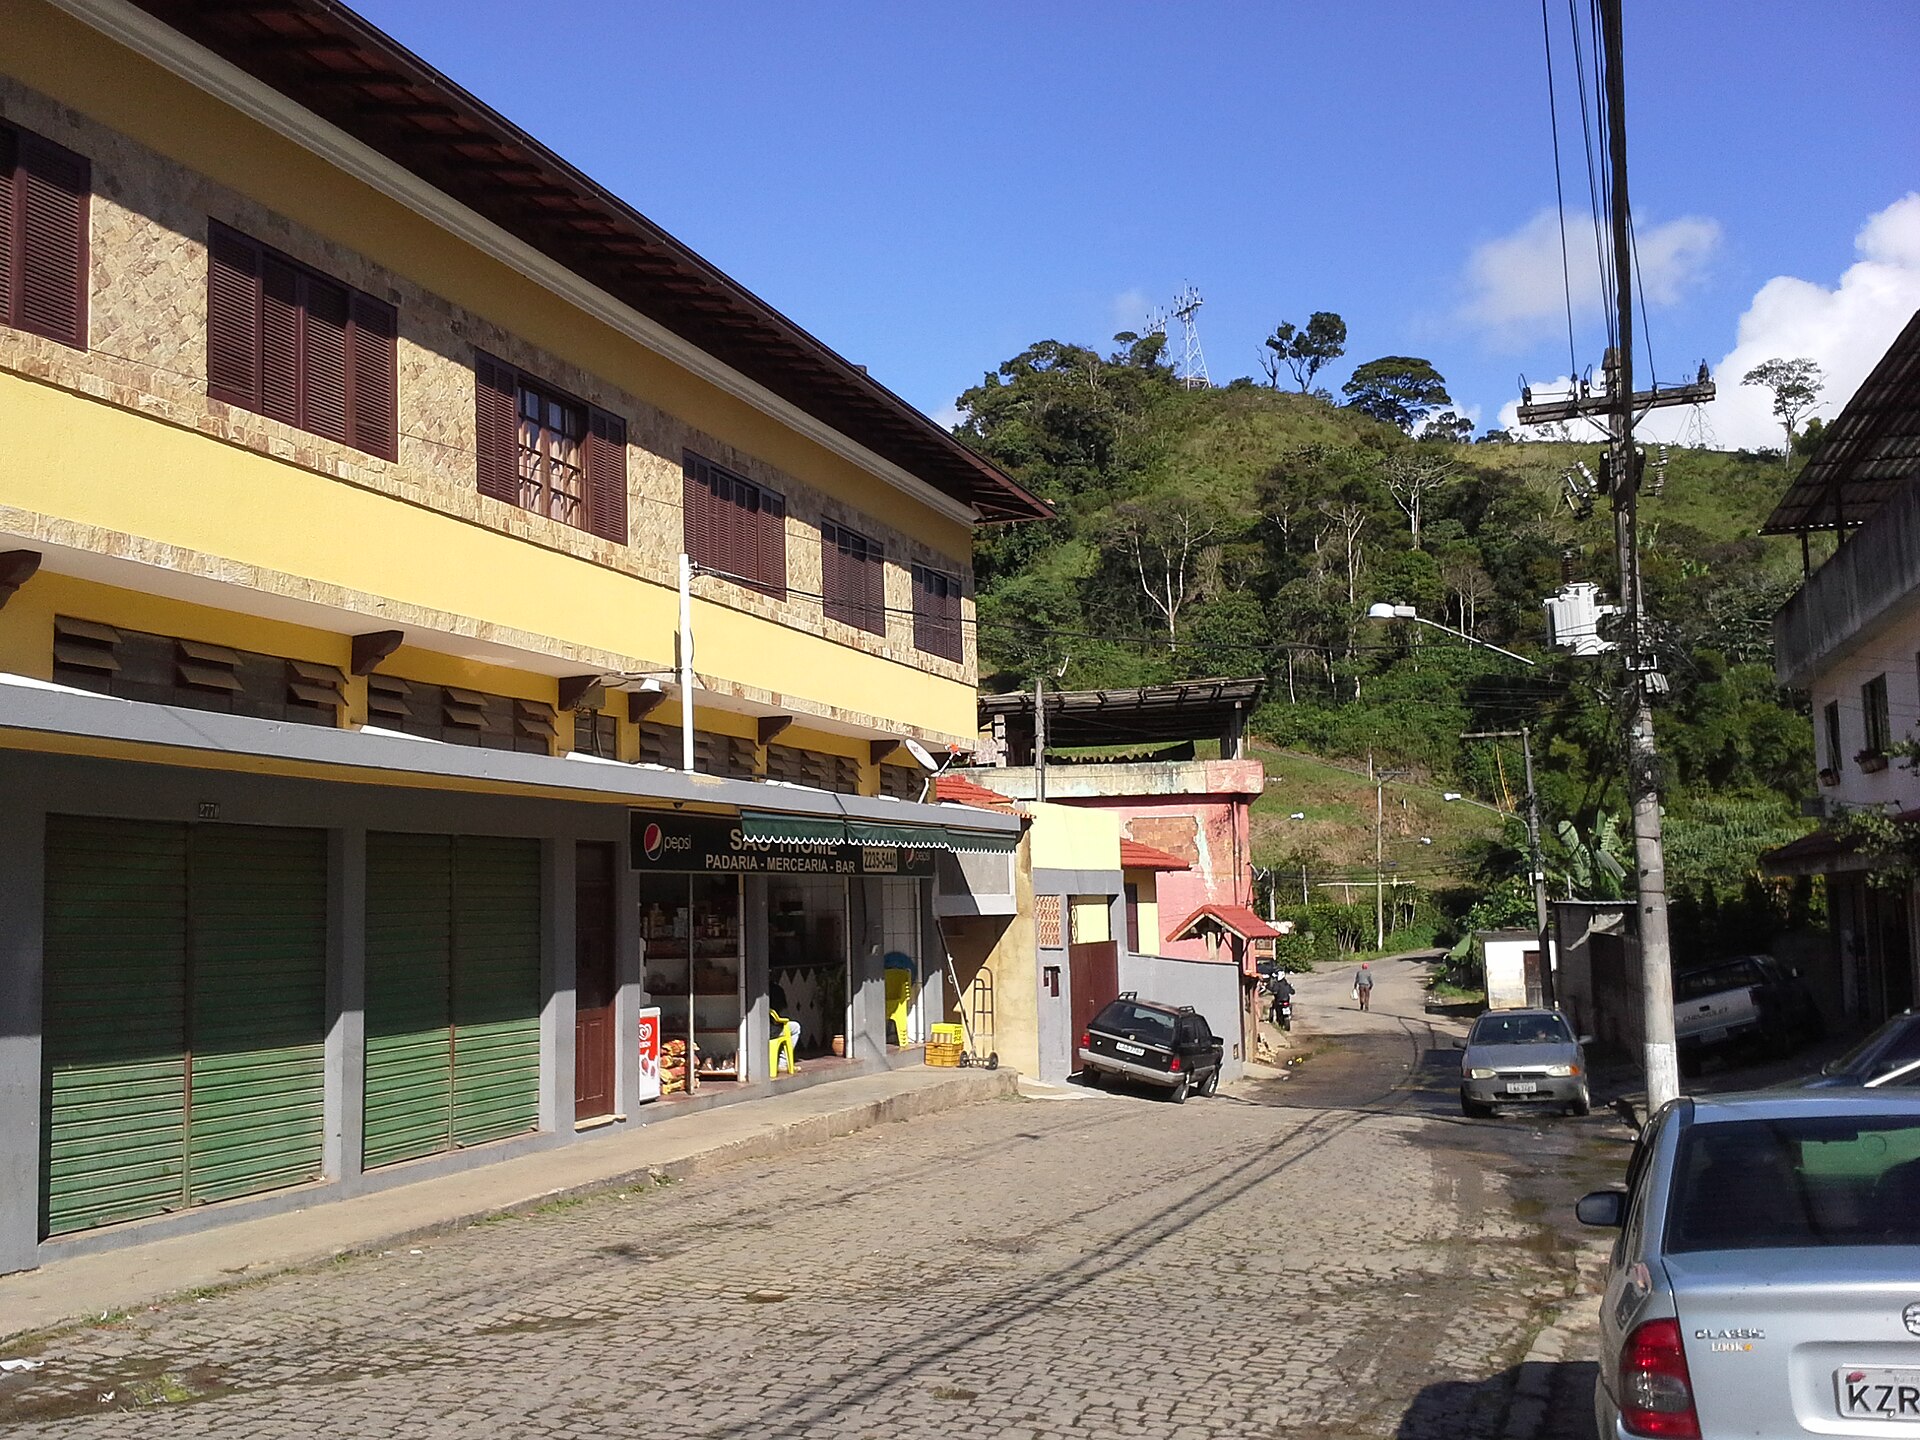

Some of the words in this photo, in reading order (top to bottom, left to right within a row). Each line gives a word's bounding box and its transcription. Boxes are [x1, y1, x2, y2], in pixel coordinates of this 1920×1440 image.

[664, 834, 692, 853] pepsi
[705, 854, 758, 870] PADARIA
[767, 857, 828, 872] MERCEARIA
[836, 860, 856, 873] BAR
[1847, 1384, 1920, 1414] KZR
